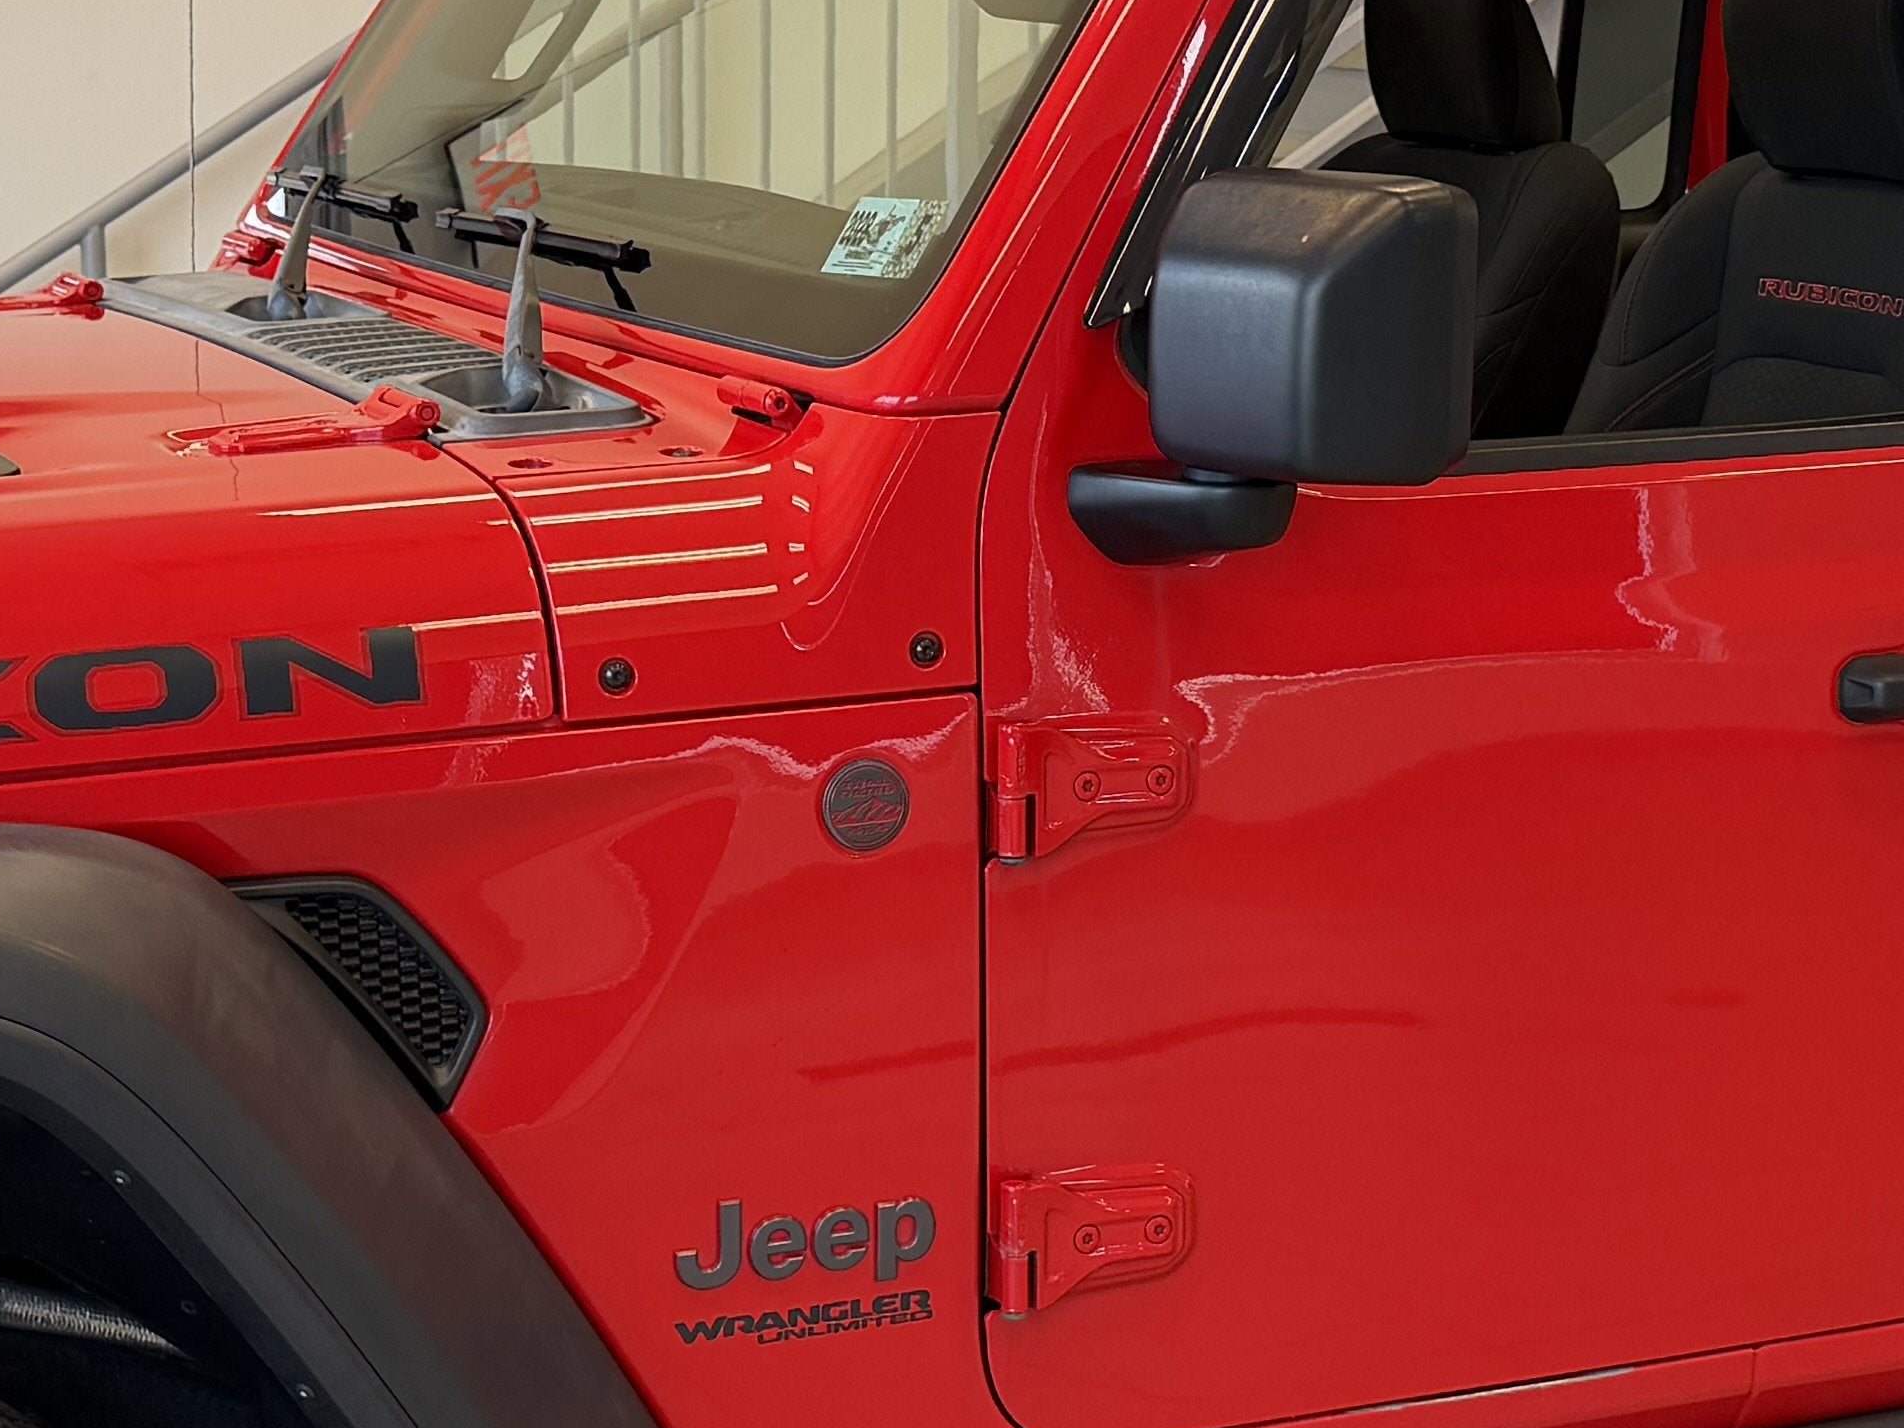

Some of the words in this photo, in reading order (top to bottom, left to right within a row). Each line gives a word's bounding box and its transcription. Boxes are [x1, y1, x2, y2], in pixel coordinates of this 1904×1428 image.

[1758, 278, 1904, 317] RUBICON
[674, 1195, 936, 1291] Jeep
[675, 1289, 932, 1345] WRANGLER
[757, 1309, 933, 1344] UNLIMITED
